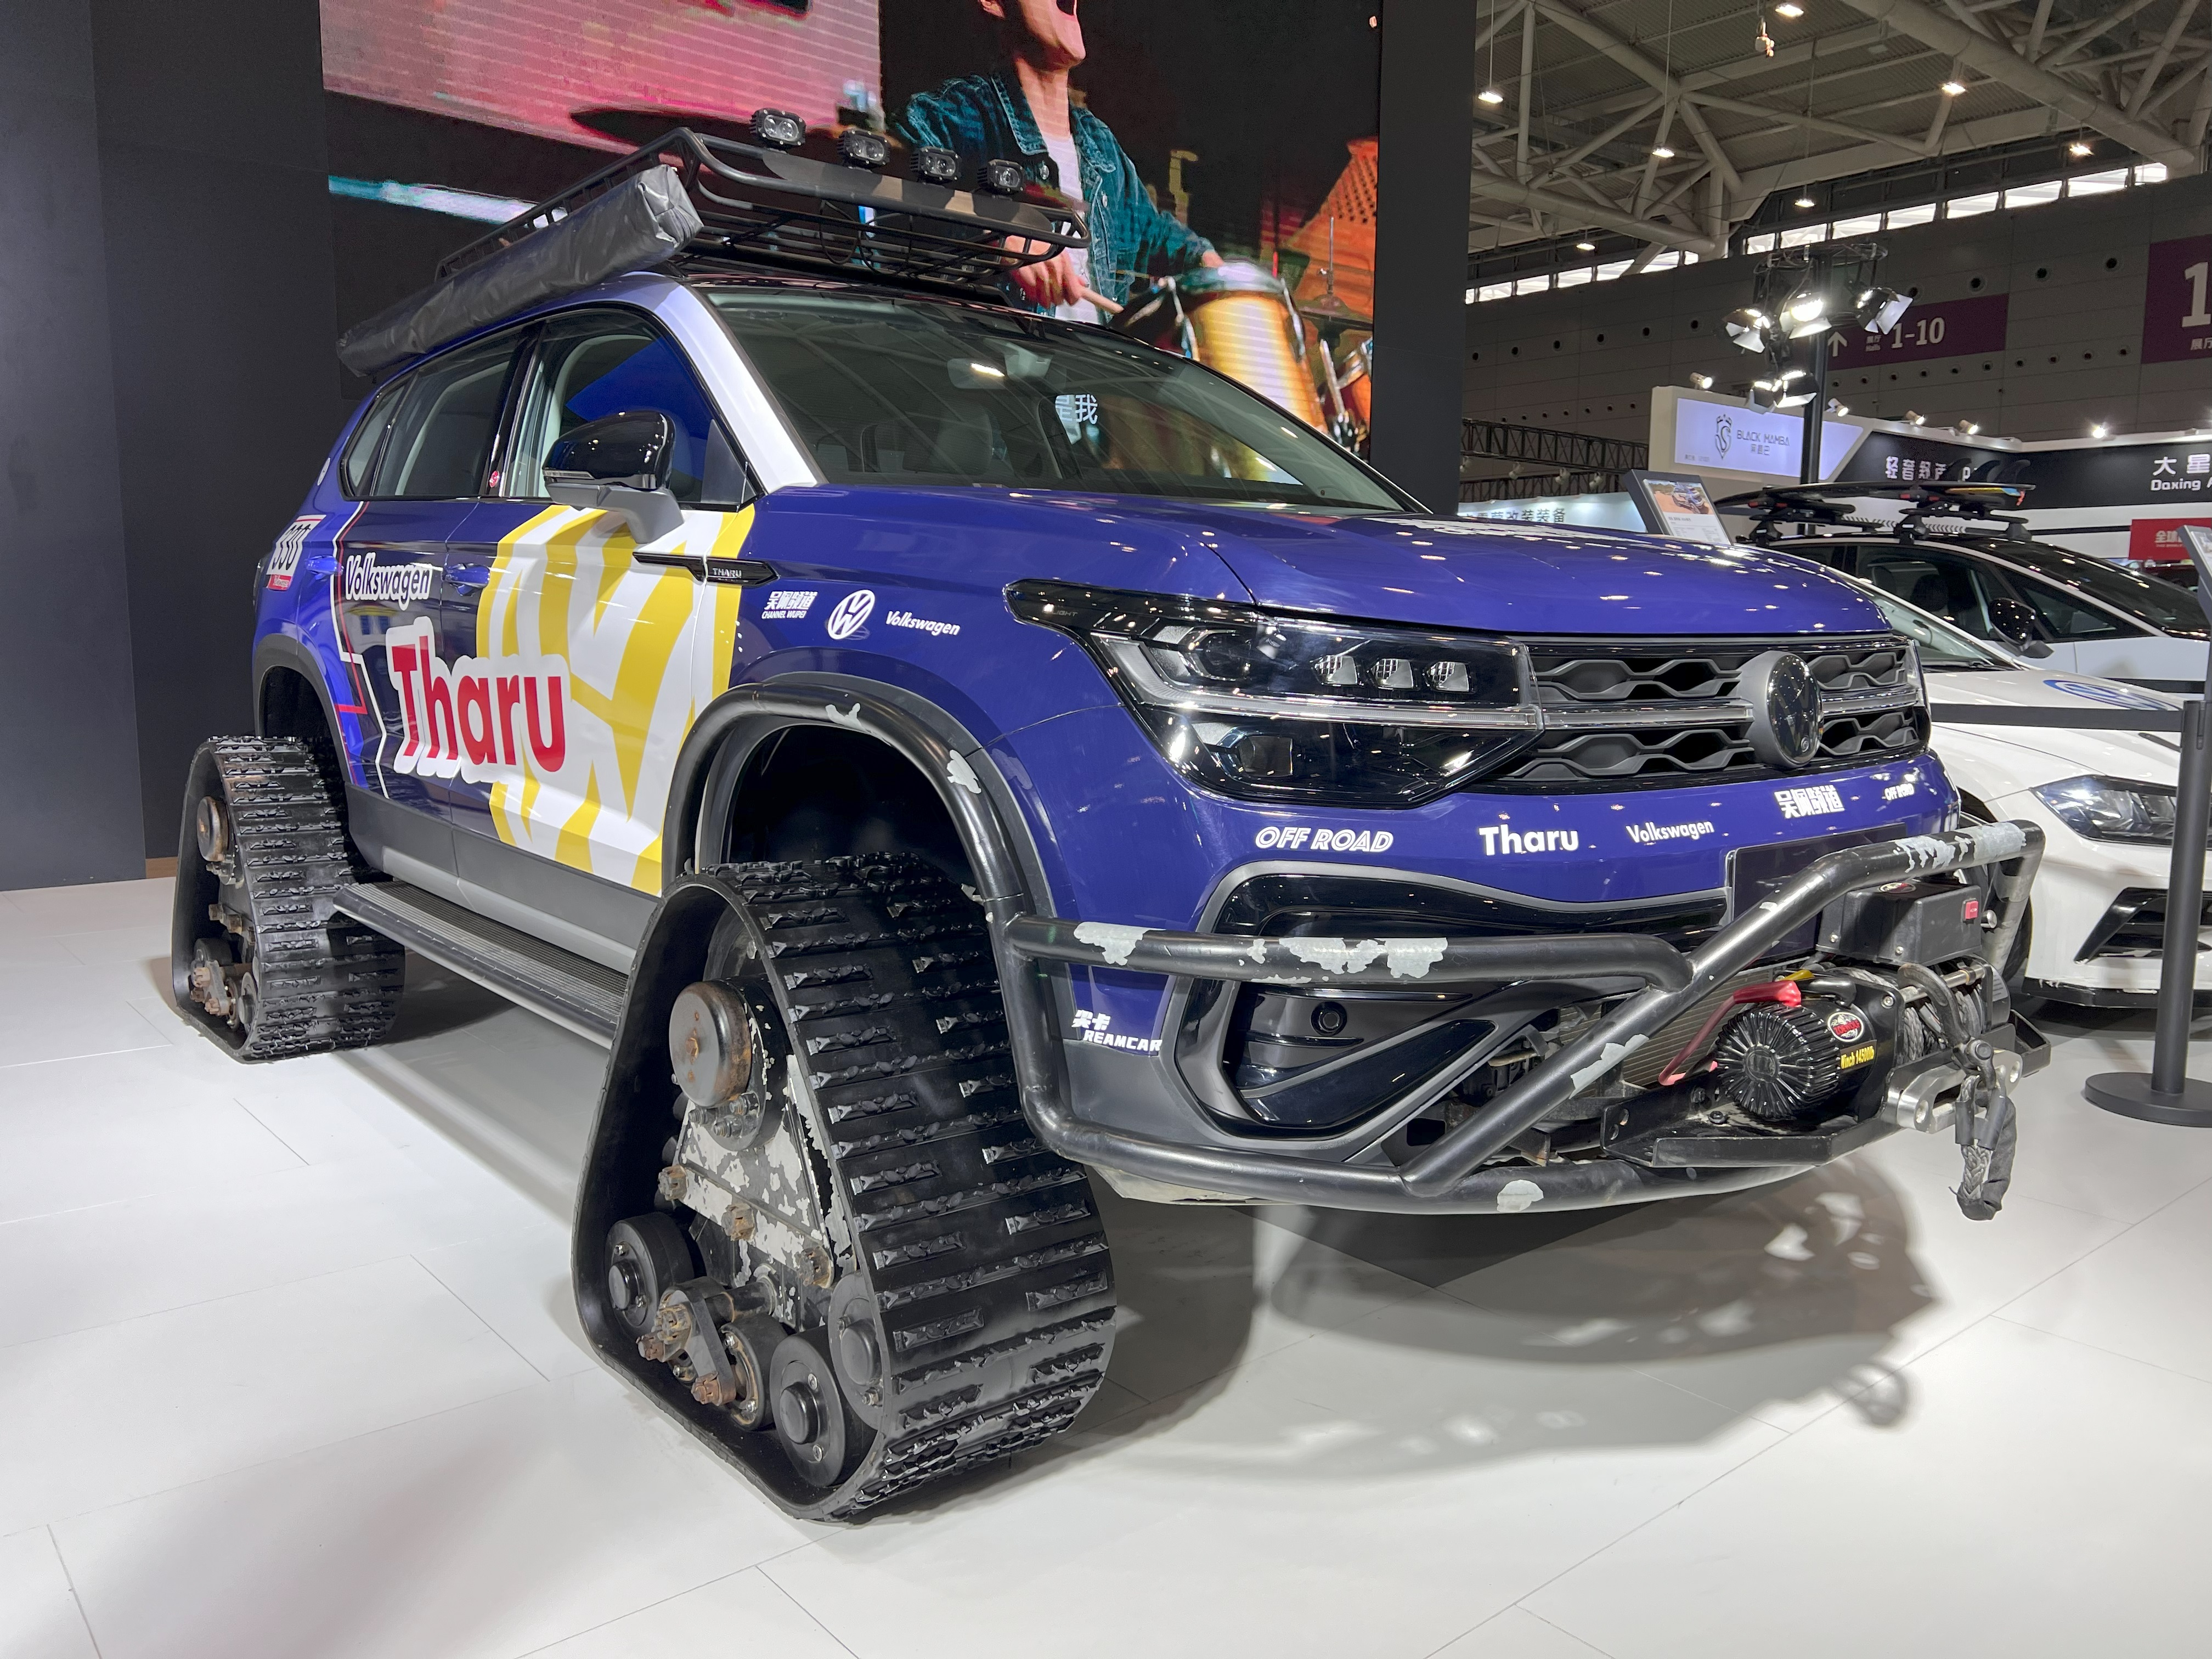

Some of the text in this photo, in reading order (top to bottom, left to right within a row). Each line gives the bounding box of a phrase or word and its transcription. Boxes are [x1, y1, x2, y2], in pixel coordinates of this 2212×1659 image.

[1891, 317, 1945, 349] 1-10
[1736, 430, 1790, 447] BLACK MAMBA
[2152, 453, 2211, 476] 大星
[2150, 478, 2201, 491] Daxing
[346, 553, 431, 609] Volkswagen
[712, 567, 742, 578] THARU
[761, 610, 807, 619] CHANNEL WUPEI
[885, 610, 961, 636] Volkswagen
[391, 635, 566, 772] Tharu
[1884, 786, 1898, 801] OFF
[1255, 826, 1394, 853] OFF ROAD
[1479, 823, 1579, 856] Tharu
[1626, 820, 1714, 843] Volkswagen
[1083, 1029, 1163, 1052] REAMCAR
